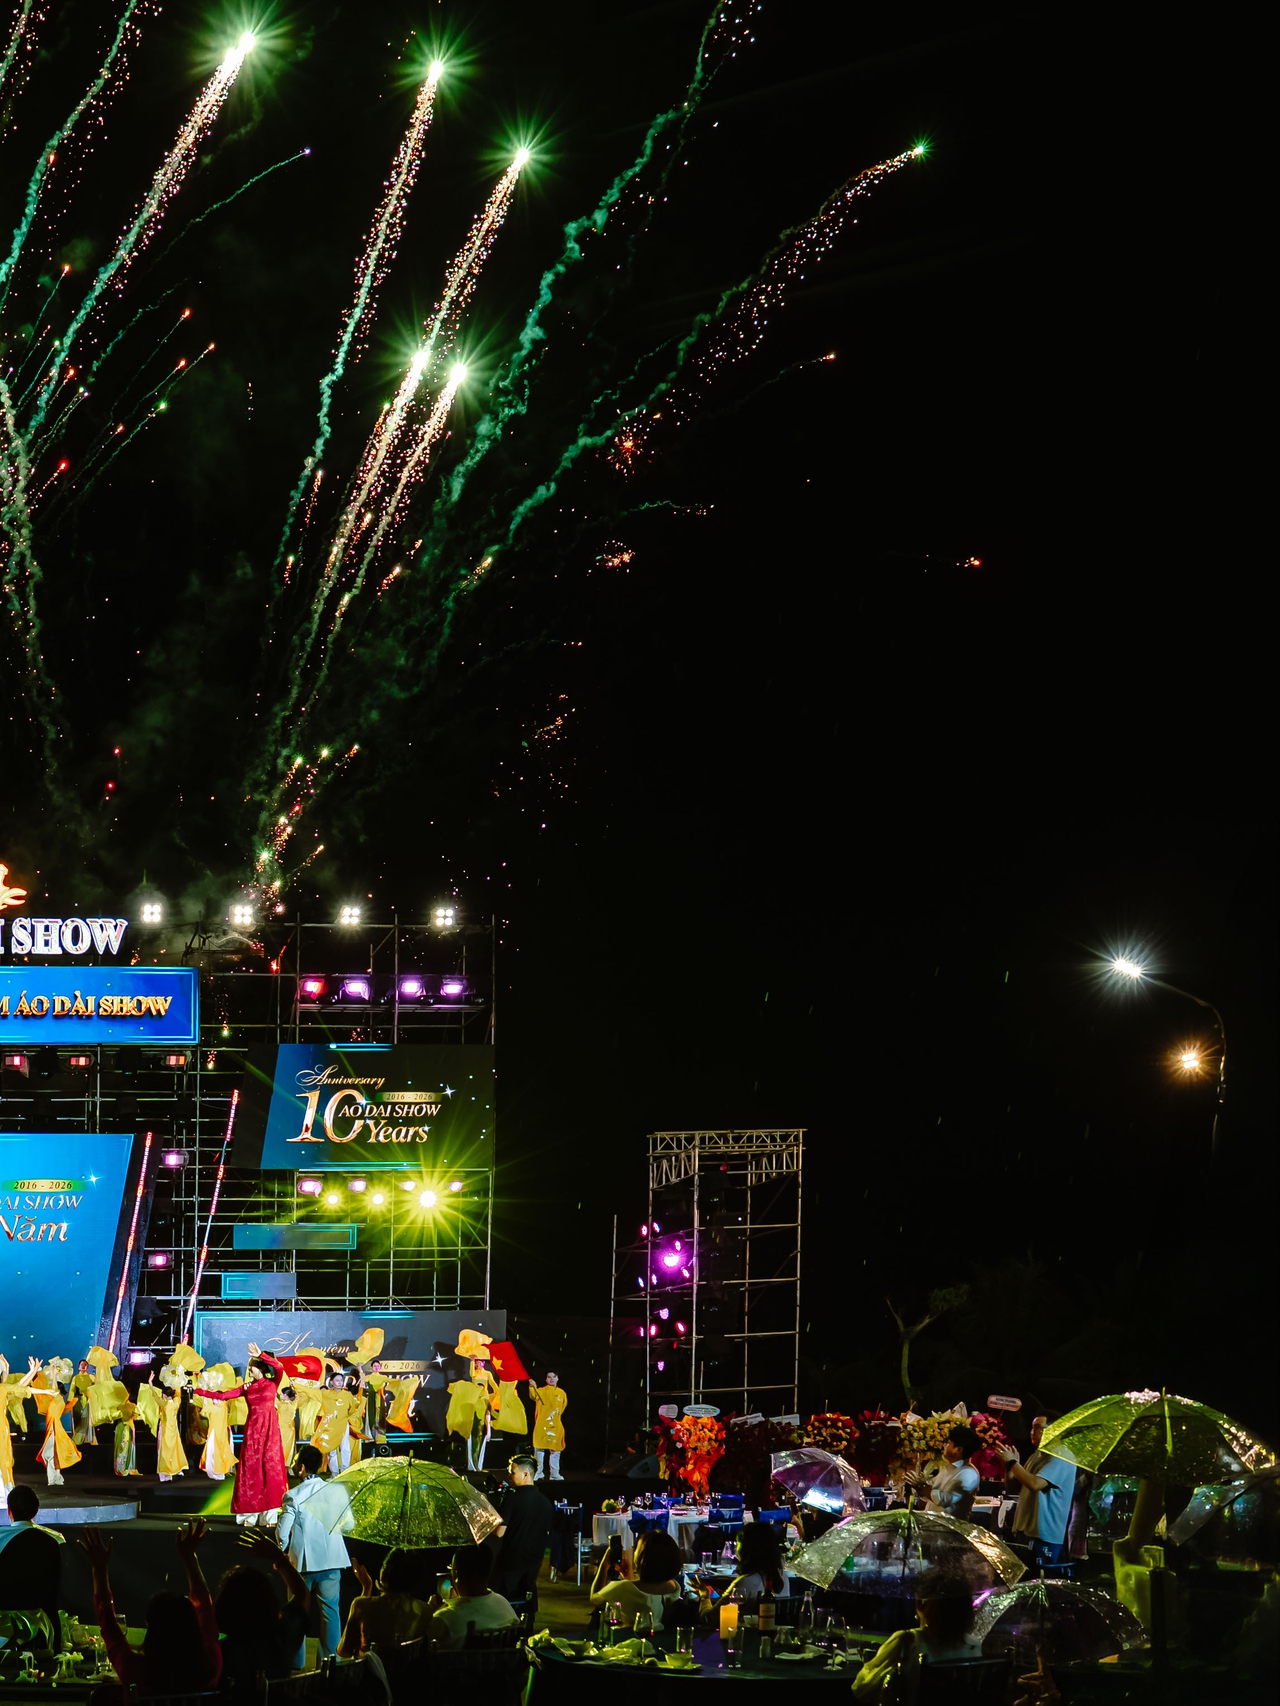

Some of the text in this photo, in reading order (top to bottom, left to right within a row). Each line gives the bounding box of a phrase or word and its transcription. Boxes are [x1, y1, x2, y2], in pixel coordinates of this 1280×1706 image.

[11, 917, 128, 955] SHOW
[14, 990, 50, 1016] ÁO
[53, 990, 96, 1016] DÀI
[99, 995, 172, 1016] SHOW
[295, 1064, 385, 1090] Anniversary
[286, 1088, 428, 1143] 10 Years
[338, 1103, 441, 1117] AO DAI SHOW
[13, 1181, 37, 1190] 2016
[49, 1181, 72, 1190] 2026
[22, 1195, 83, 1210] SHOW
